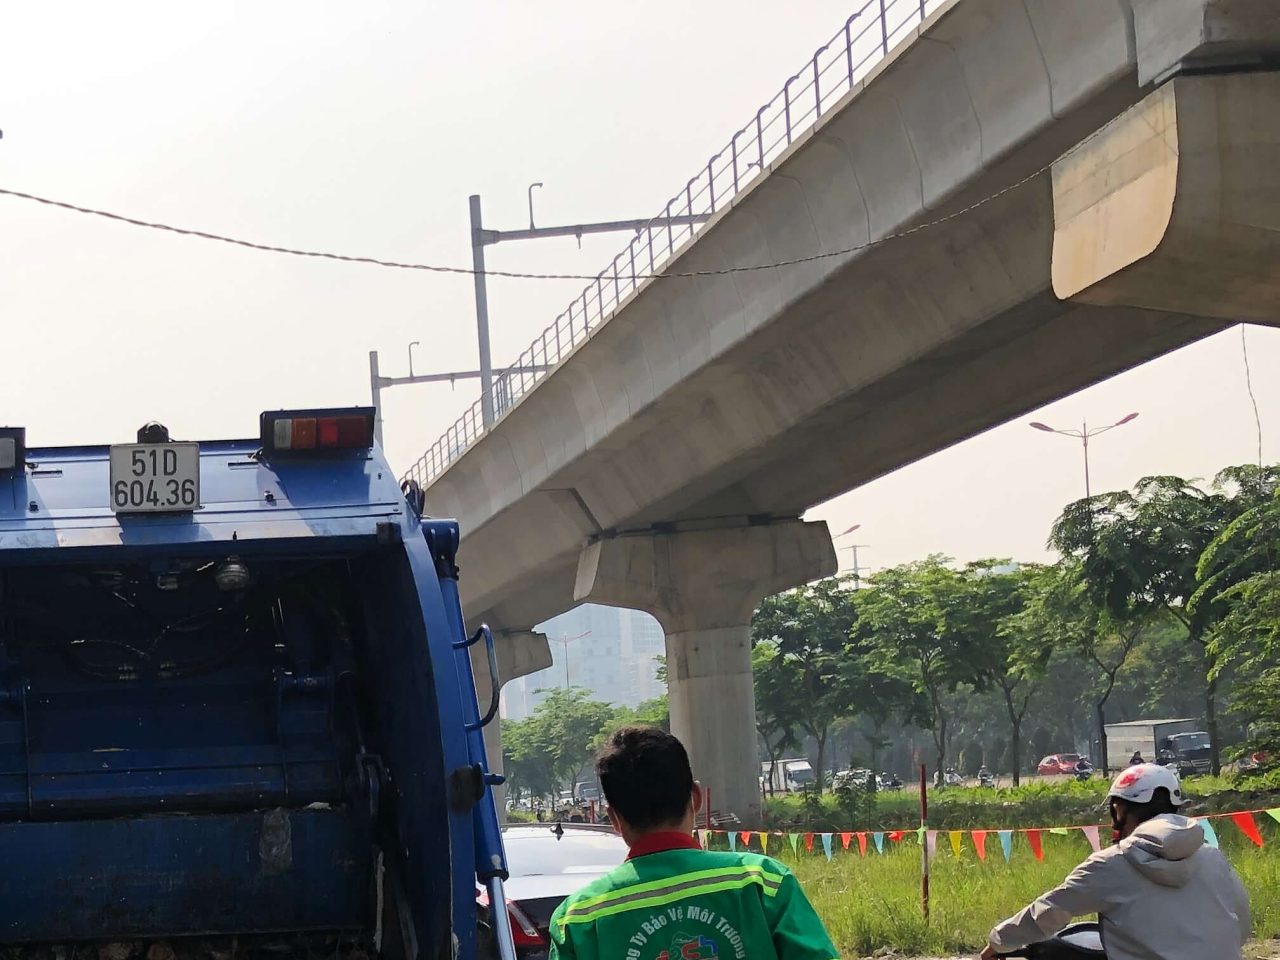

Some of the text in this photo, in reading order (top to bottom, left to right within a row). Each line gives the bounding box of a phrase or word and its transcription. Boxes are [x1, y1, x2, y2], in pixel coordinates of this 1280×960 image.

[131, 449, 177, 477] 51D
[114, 479, 195, 507] 604.36
[630, 932, 648, 947] Ty
[641, 914, 668, 935] Bảo
[667, 906, 685, 922] Vệ
[687, 905, 716, 925] Môi
